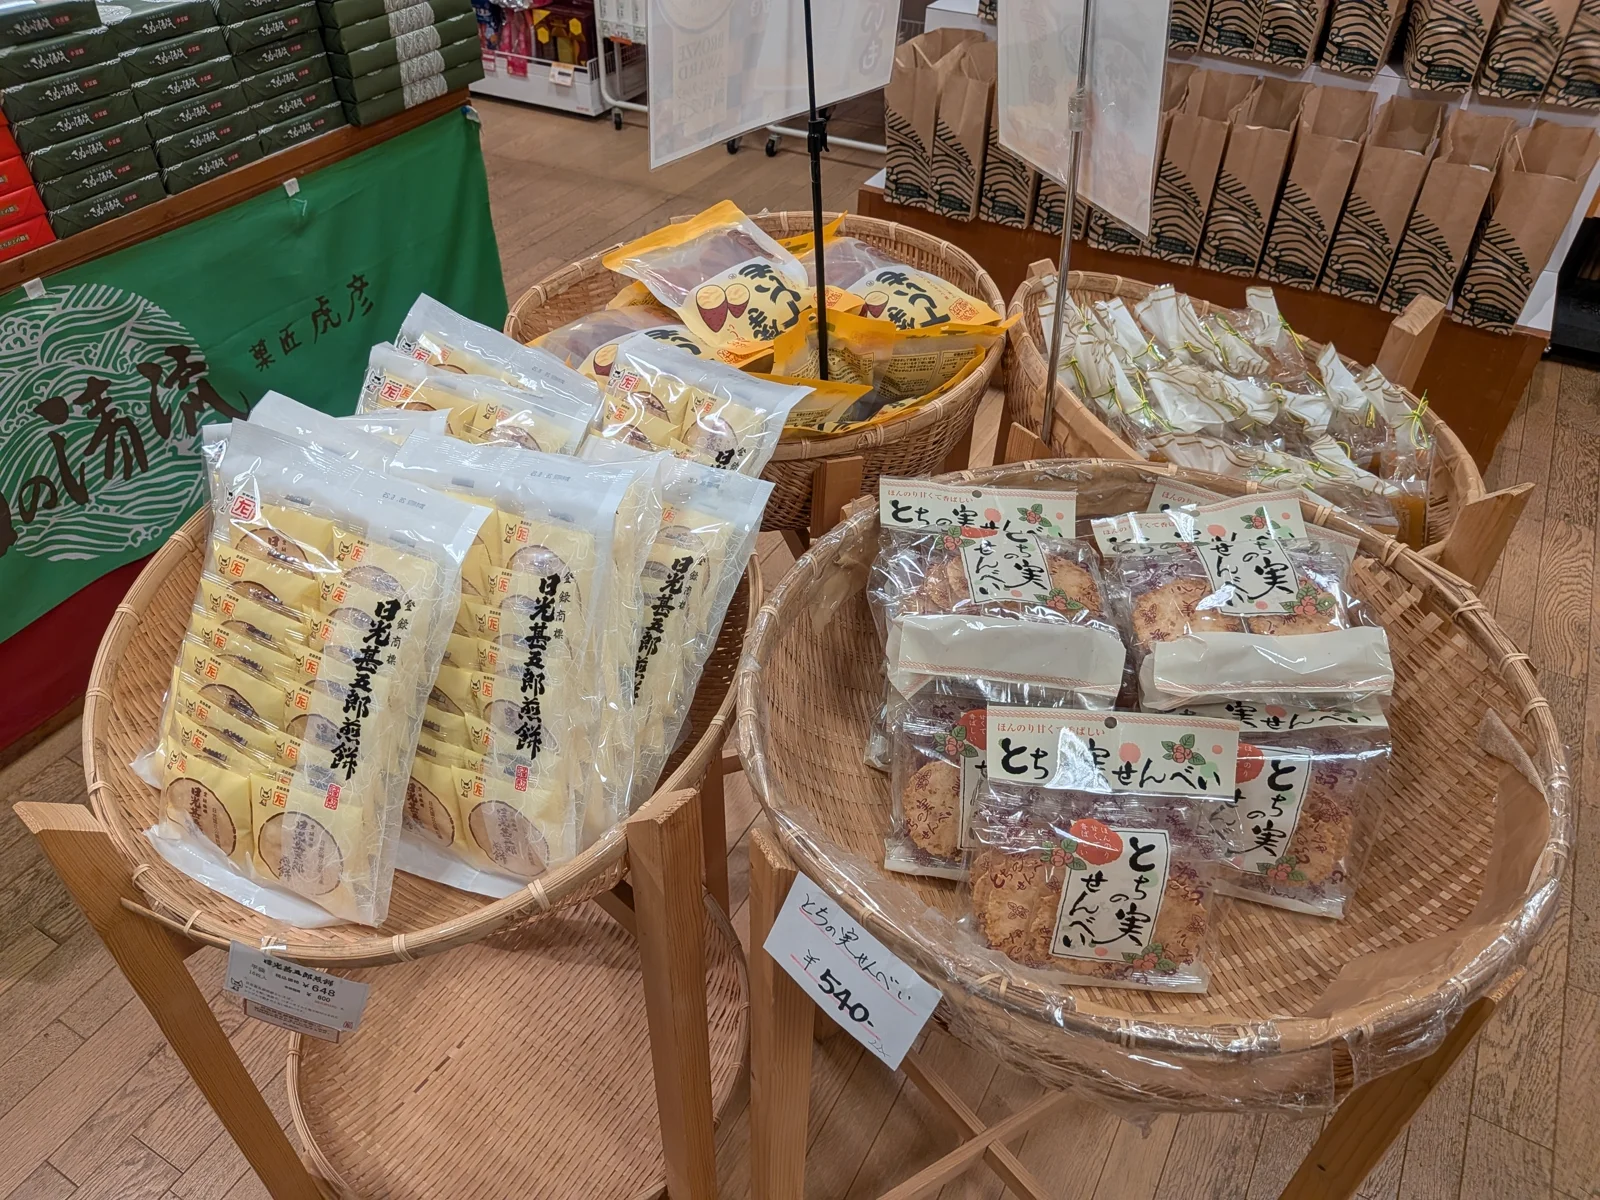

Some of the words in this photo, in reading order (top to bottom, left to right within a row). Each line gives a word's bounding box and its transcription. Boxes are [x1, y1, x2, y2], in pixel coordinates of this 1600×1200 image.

[0, 345, 251, 552] の清流
[887, 489, 974, 504] ほんのり甘くて香ばしい
[329, 598, 402, 781] 日光甚五郎煎餅
[515, 573, 561, 761] 日光甚五郎煎餅
[1225, 760, 1296, 857] とちの実
[1062, 871, 1109, 948] せんべい
[1091, 837, 1157, 947] とちの実
[799, 893, 912, 1002] とちの実せんべい
